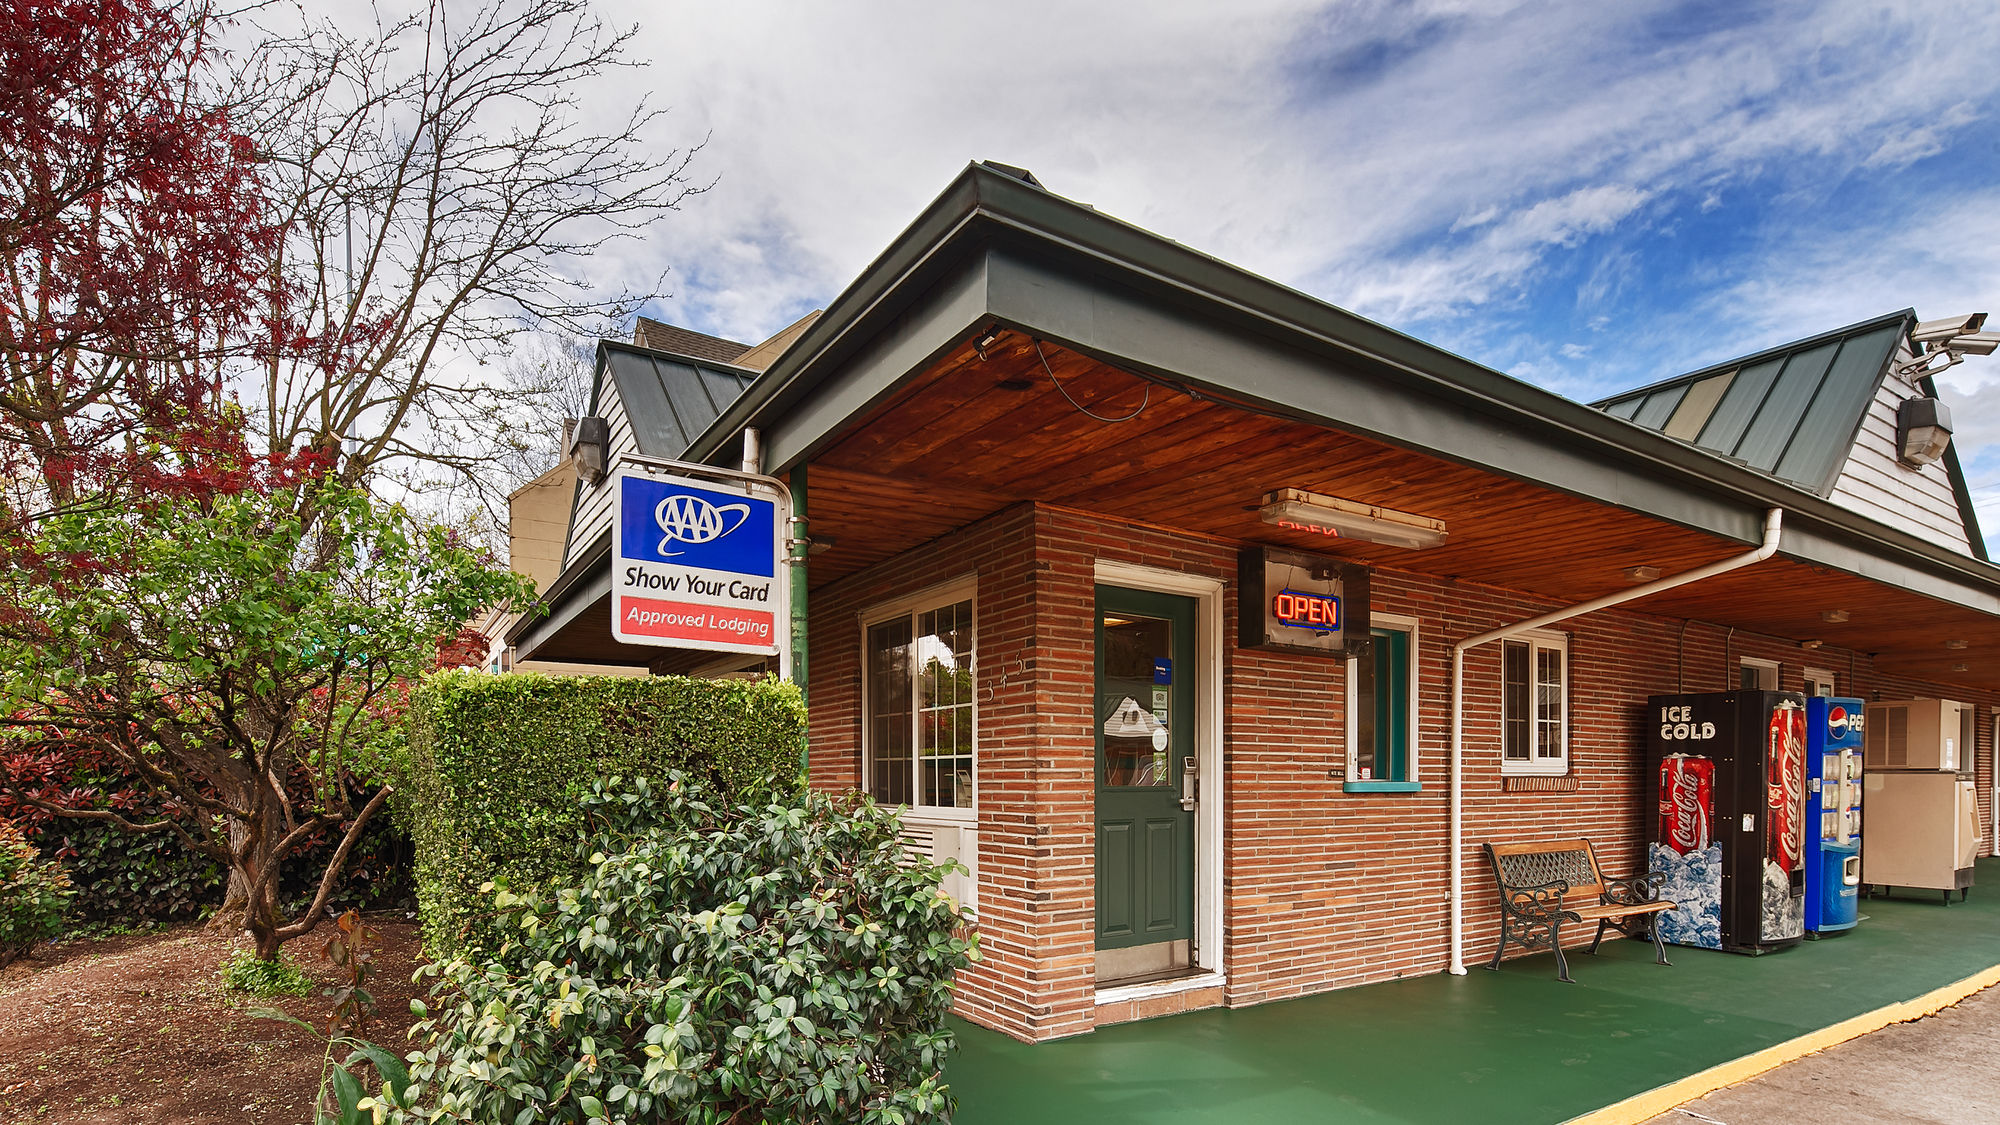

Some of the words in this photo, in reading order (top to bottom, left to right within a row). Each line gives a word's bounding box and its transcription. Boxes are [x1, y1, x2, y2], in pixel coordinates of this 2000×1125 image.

[662, 497, 718, 542] AAA
[624, 566, 680, 591] Show
[685, 574, 725, 596] Your
[728, 580, 770, 602] Card
[626, 606, 705, 629] Approved
[709, 614, 769, 638] Lodging
[1277, 594, 1337, 625] OPEN
[1661, 706, 1692, 722] ICE
[1660, 722, 1716, 741] COLD
[1672, 770, 1699, 847] Coca-Cola
[1781, 731, 1801, 861] Coca-Cola
